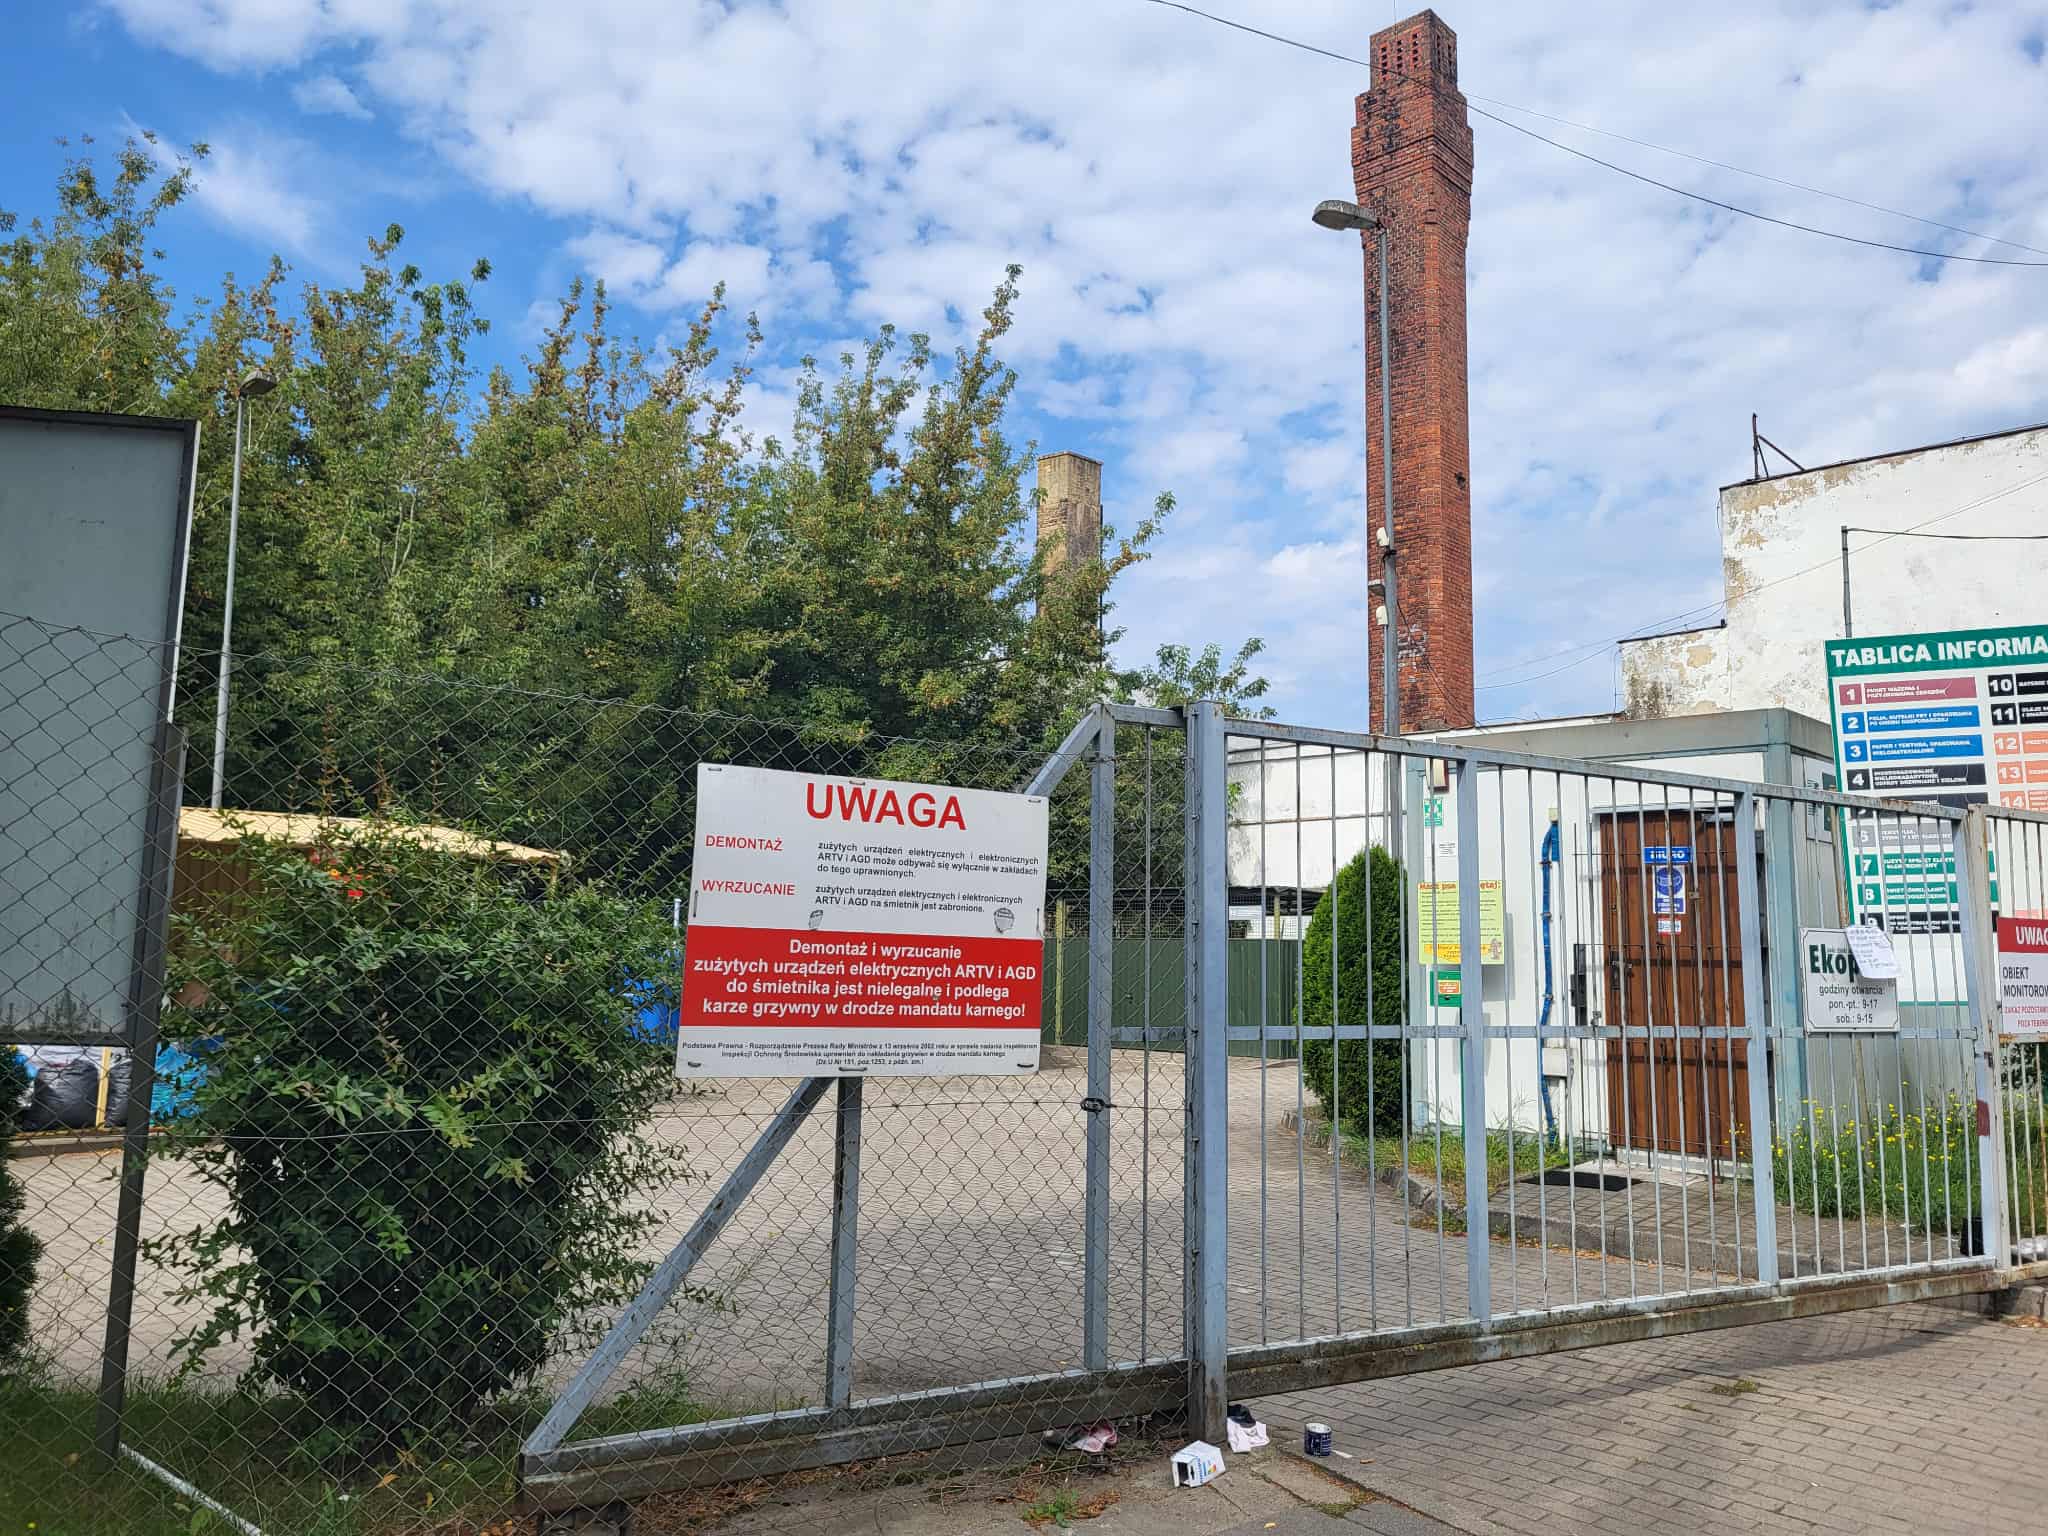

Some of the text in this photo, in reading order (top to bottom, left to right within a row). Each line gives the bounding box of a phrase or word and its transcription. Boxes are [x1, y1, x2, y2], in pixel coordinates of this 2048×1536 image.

[1831, 643, 1931, 667] TABLICA
[1990, 679, 2012, 692] 10
[1846, 688, 1856, 701] 1
[1993, 708, 2014, 721] 11
[1848, 717, 1859, 729] 2
[1996, 738, 2017, 750] 12
[1850, 745, 1861, 758] 3
[1852, 773, 1864, 786] 4
[1999, 767, 2020, 779] 13
[806, 782, 967, 831] UWAGA
[2002, 796, 2023, 808] 14
[705, 835, 783, 851] DEMONTAŻ
[818, 841, 857, 853] zużytych
[864, 845, 903, 856] urządzeń
[908, 848, 964, 860] elektrycznych
[979, 853, 1039, 866] elektronicznych
[818, 852, 843, 862] ARTV
[851, 855, 871, 864] AGD
[873, 856, 896, 866] może
[898, 858, 935, 869] odbywać
[938, 861, 950, 871] się
[952, 862, 990, 873] wyłącznie
[1000, 866, 1038, 876] zakładach
[1863, 859, 1871, 871] 7
[817, 864, 917, 879] do tego uprawnionych.
[702, 879, 796, 896] WYRZUCANIE
[816, 885, 855, 896] zużytych
[857, 887, 896, 898] urządzeń
[899, 889, 955, 901] elektrycznych
[962, 892, 1023, 905] elektronicznych
[1865, 889, 1874, 900] 8
[815, 896, 841, 905] ARTV
[848, 898, 869, 906] AGD
[871, 899, 881, 907] na
[883, 898, 919, 909] śmietnik
[920, 900, 937, 912] jest
[939, 902, 985, 913] zabronione.
[790, 939, 962, 960] Demontaż i wyrzucanie
[694, 957, 1036, 981] zużytych urządzeń elektrycznych ARTV i AGD
[2003, 966, 2029, 979] OBIEKT
[726, 978, 1009, 1001] do śmietnika jest nielegalne i podlega
[1819, 984, 1886, 997] godziny otwarcia:
[703, 998, 1025, 1019] karze grzywny w drodze mandatu karnego!
[1862, 1000, 1879, 1009] 9-17
[1857, 1014, 1873, 1024] 9-15
